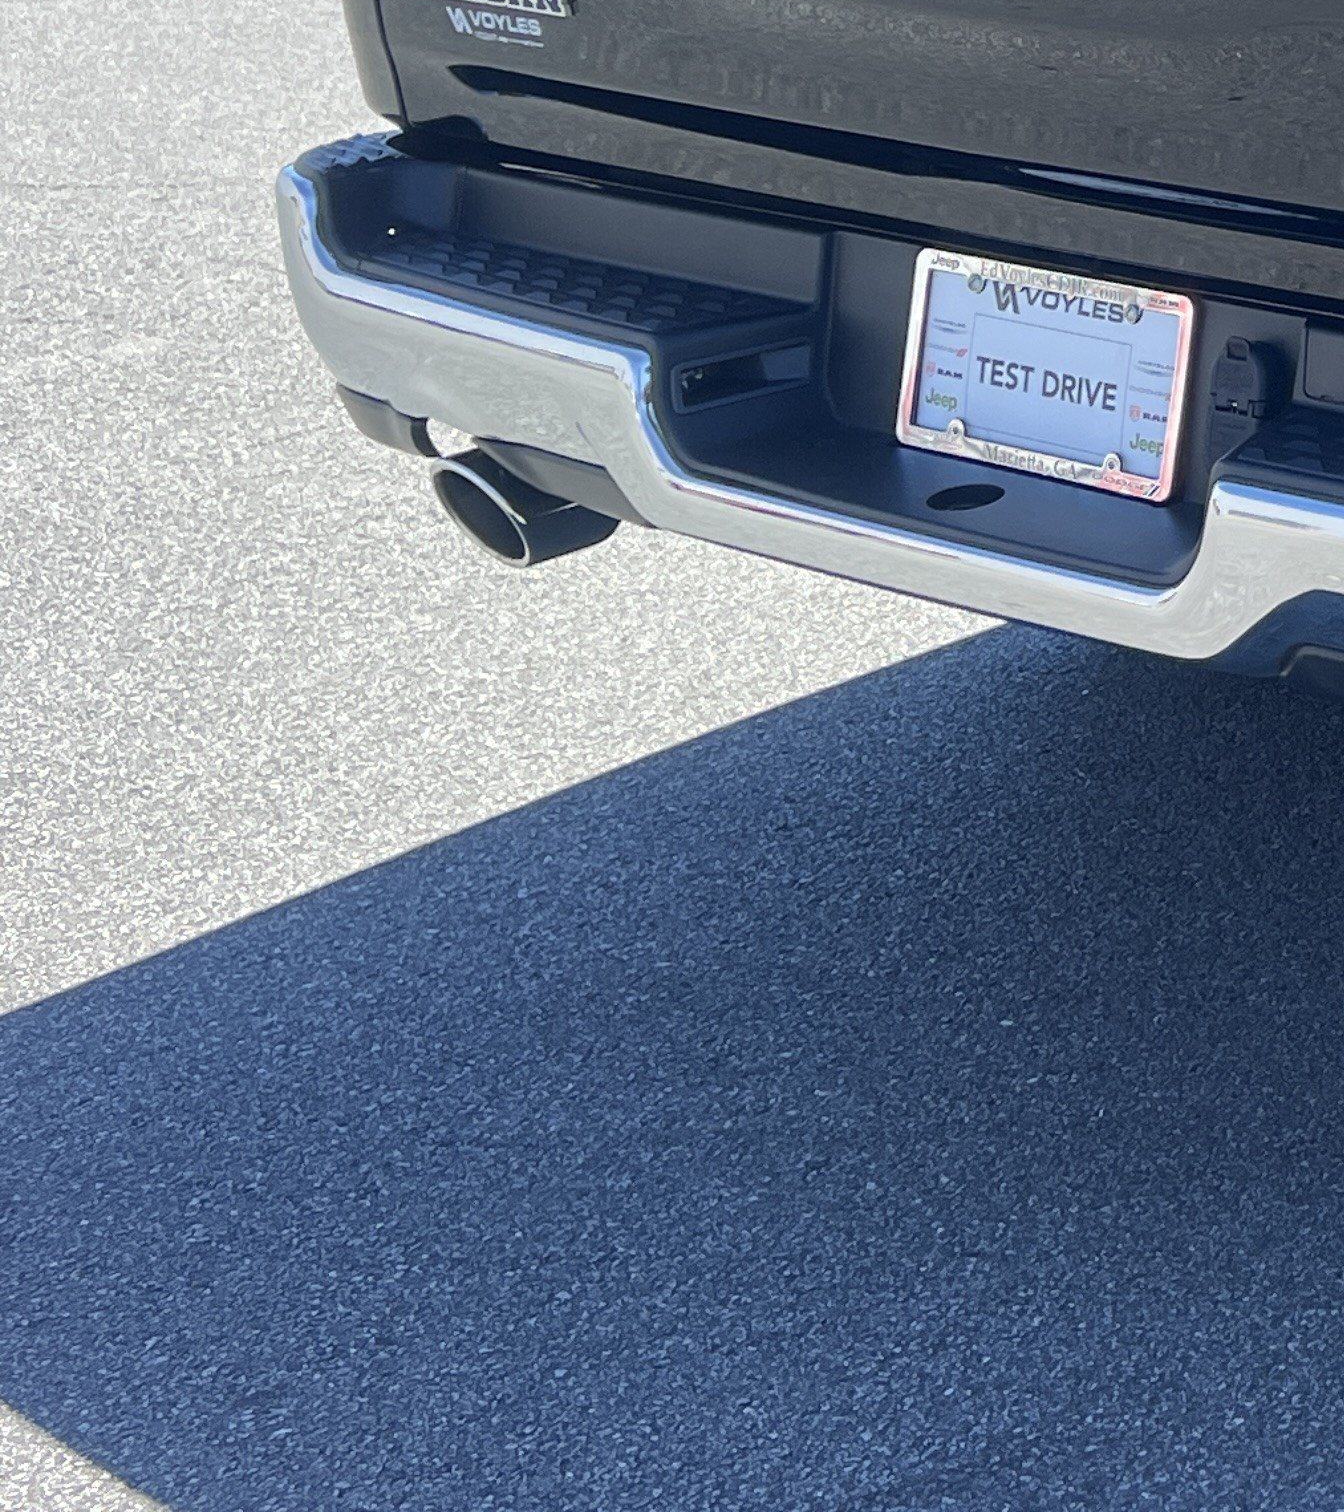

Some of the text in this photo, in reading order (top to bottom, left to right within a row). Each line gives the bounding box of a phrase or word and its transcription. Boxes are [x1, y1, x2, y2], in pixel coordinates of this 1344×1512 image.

[467, 9, 542, 36] VOYLES
[930, 253, 961, 271] Jeep
[1020, 286, 1124, 324] VOYLES
[976, 356, 1117, 411] TEST DRIVE
[925, 387, 958, 412] Jeep
[1129, 432, 1165, 458] Jeep
[983, 443, 1079, 480] Marietta, GA
